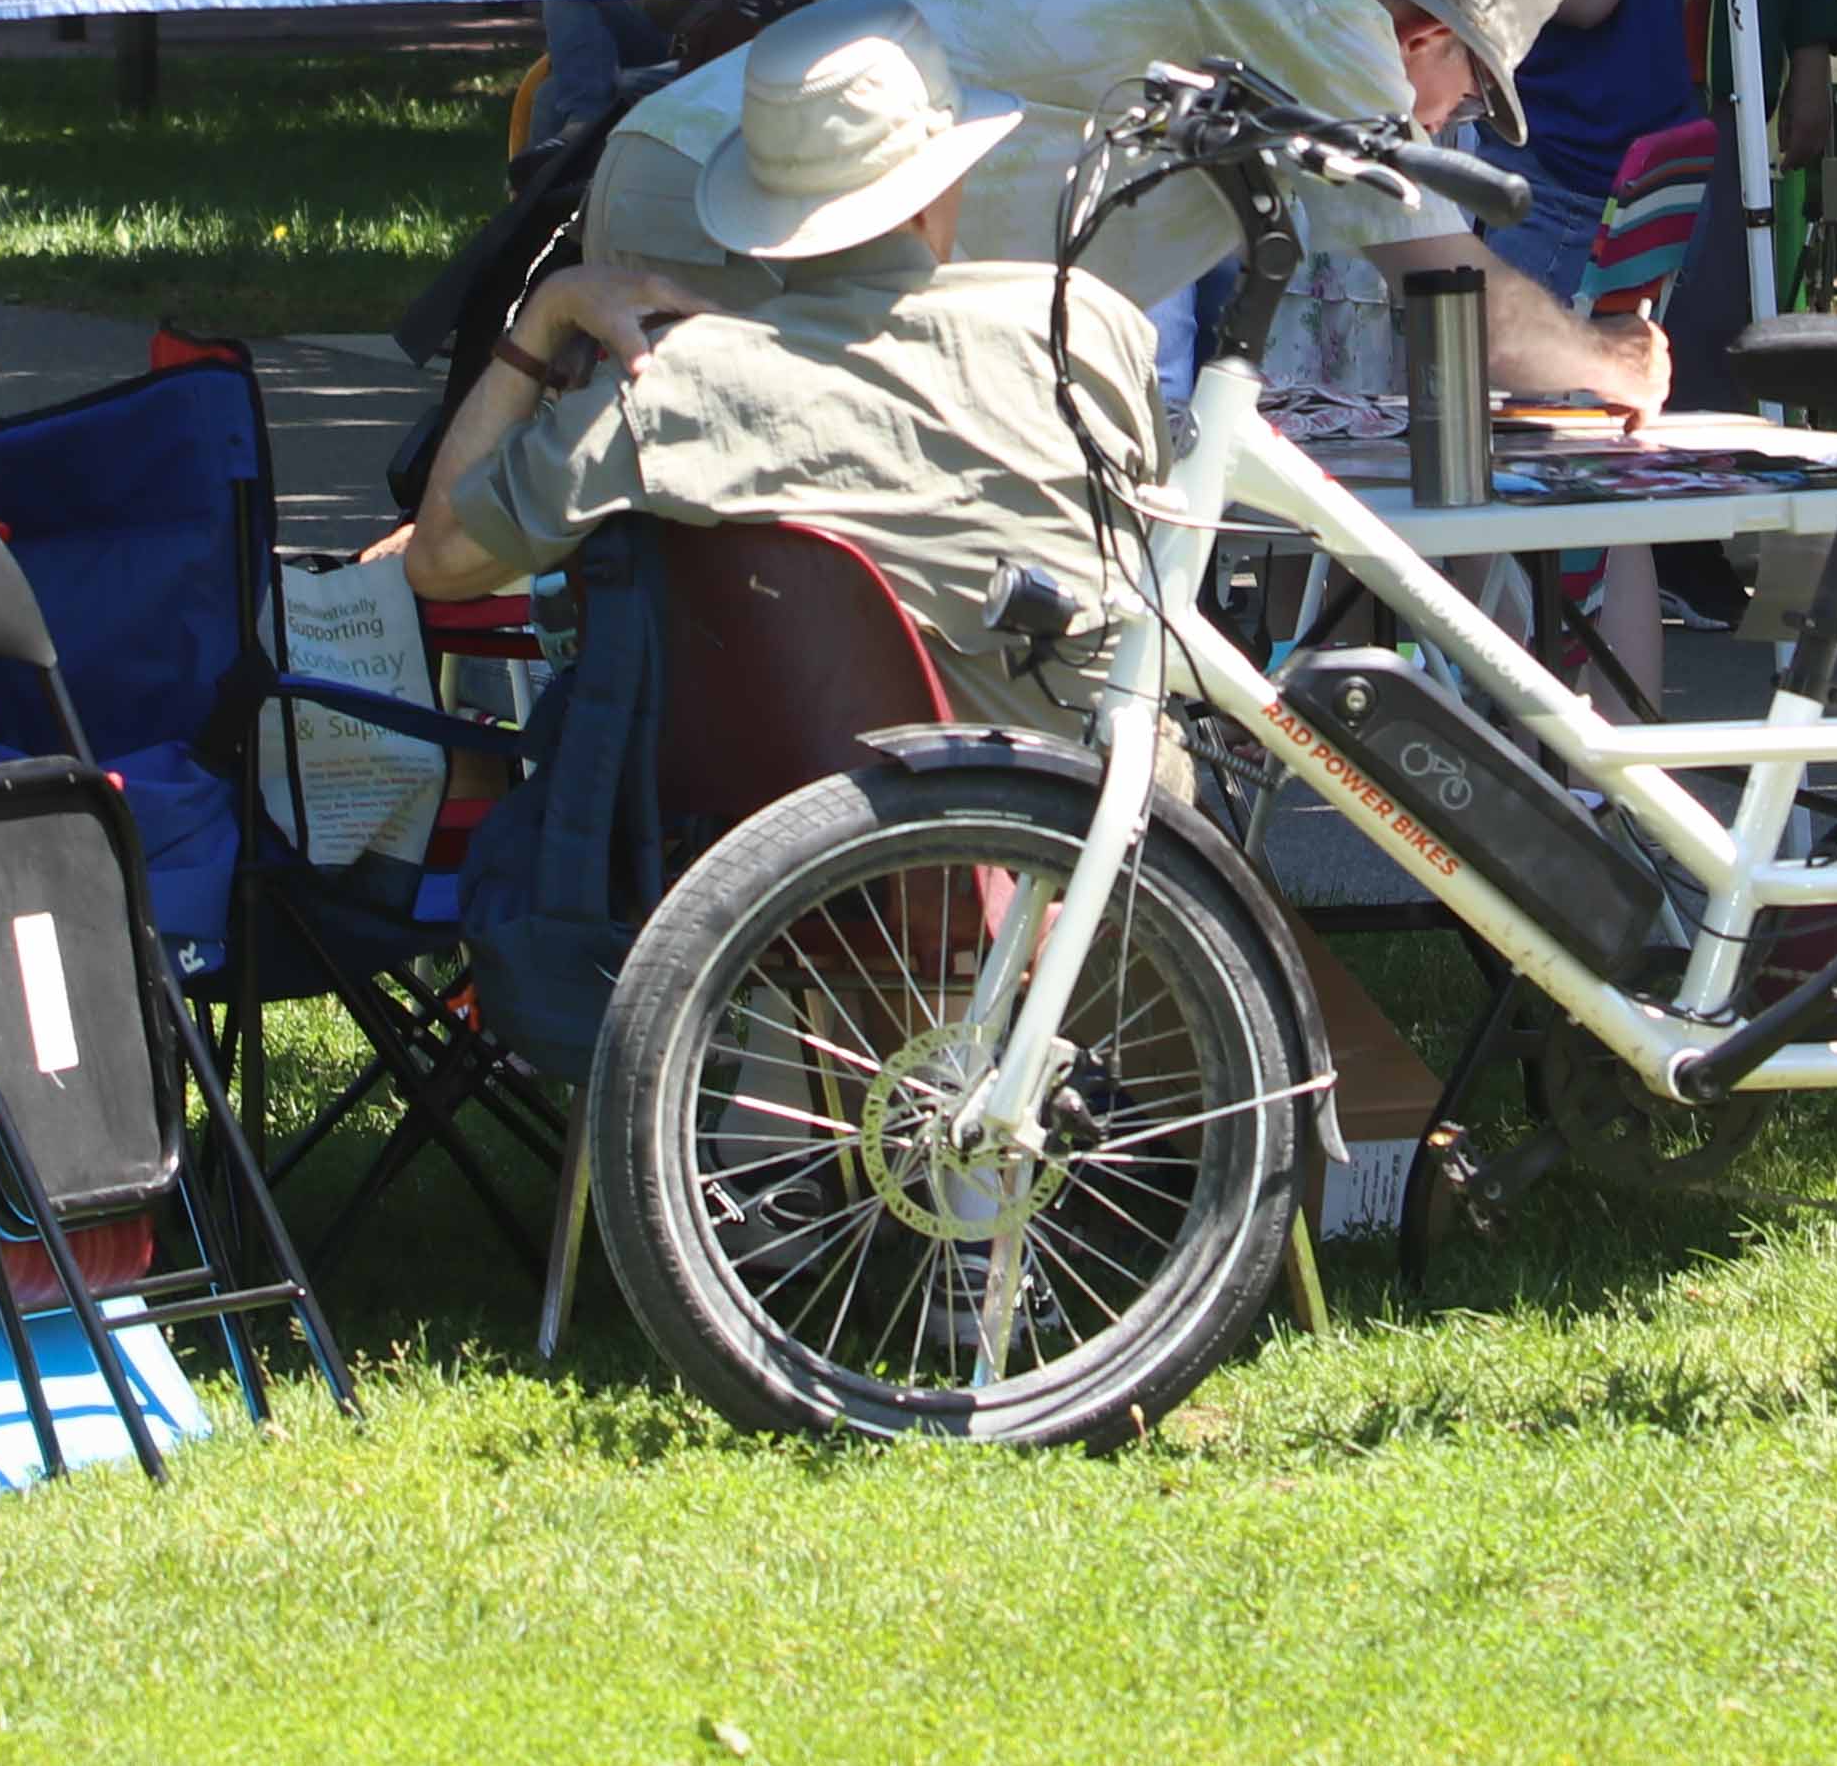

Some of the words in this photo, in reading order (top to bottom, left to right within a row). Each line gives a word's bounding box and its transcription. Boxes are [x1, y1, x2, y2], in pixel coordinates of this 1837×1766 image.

[287, 616, 385, 644] Supporting
[1261, 701, 1314, 747] RAD
[1308, 741, 1395, 820] POWER
[1391, 813, 1461, 877] BIKES
